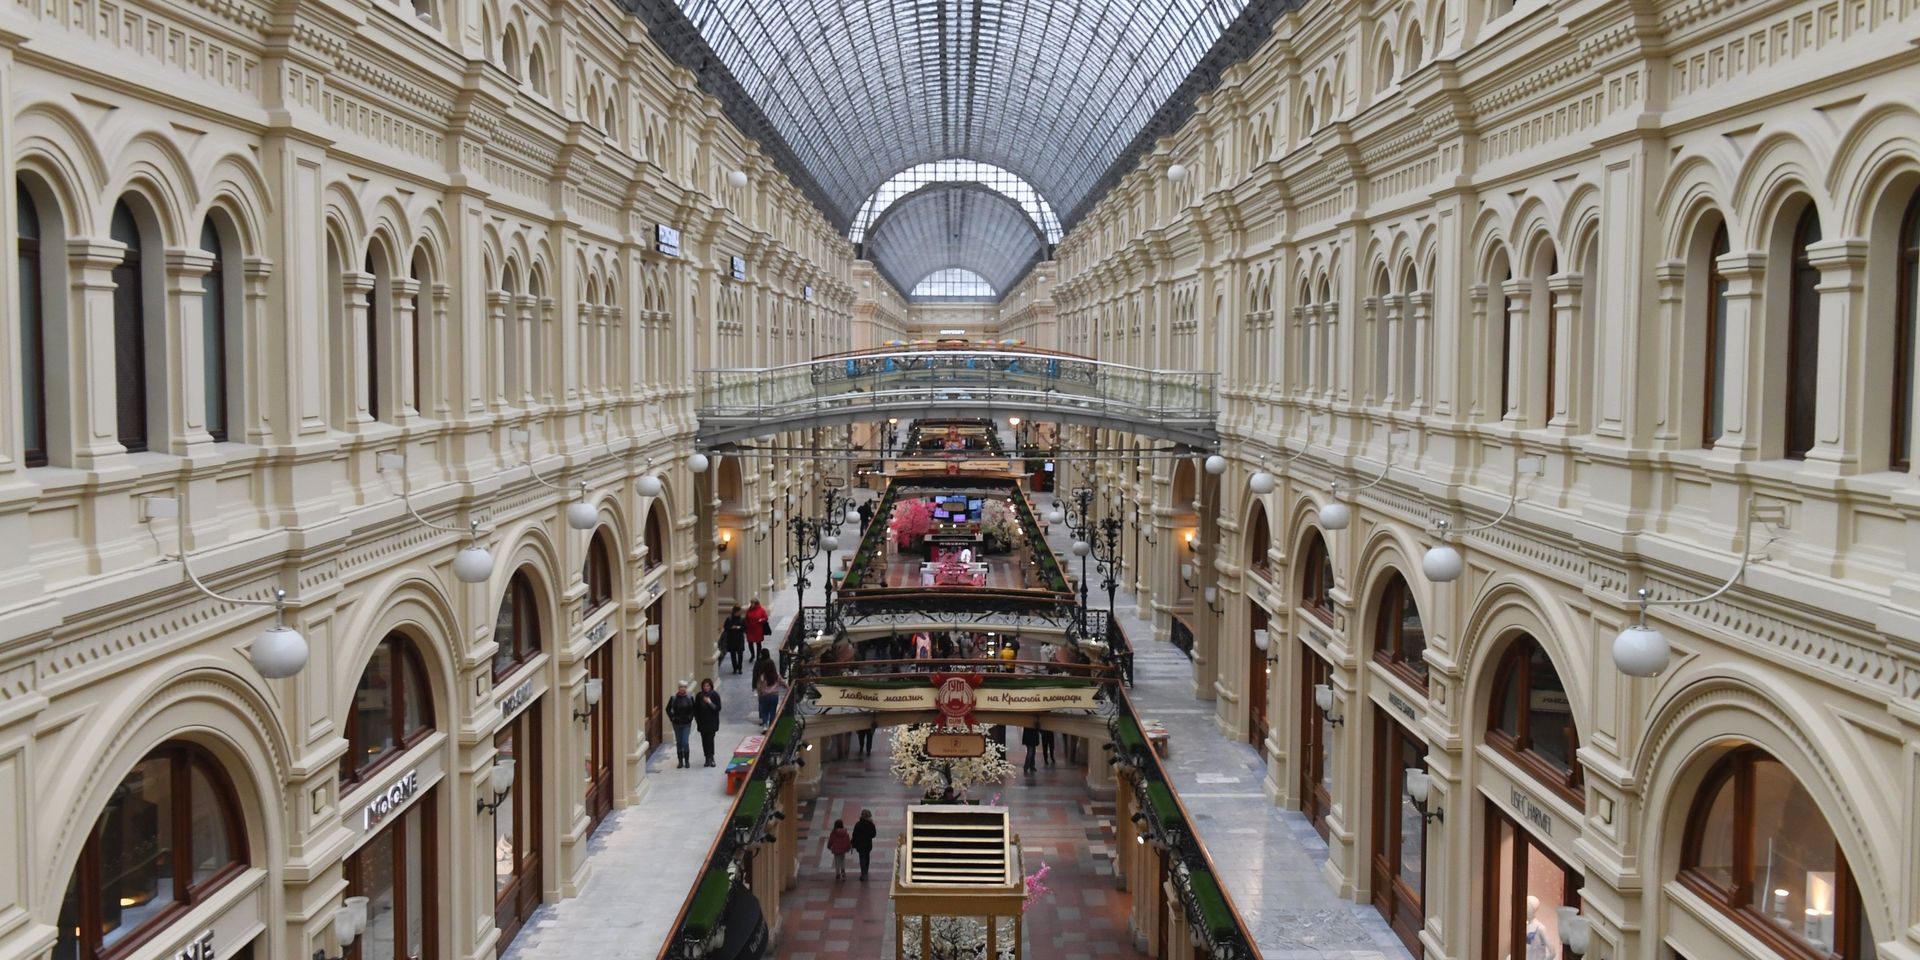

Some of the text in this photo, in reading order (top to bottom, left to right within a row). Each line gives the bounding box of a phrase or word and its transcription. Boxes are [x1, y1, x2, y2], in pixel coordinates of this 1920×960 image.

[838, 688, 924, 702] Главный магазин
[987, 692, 1082, 705] на Красной площади
